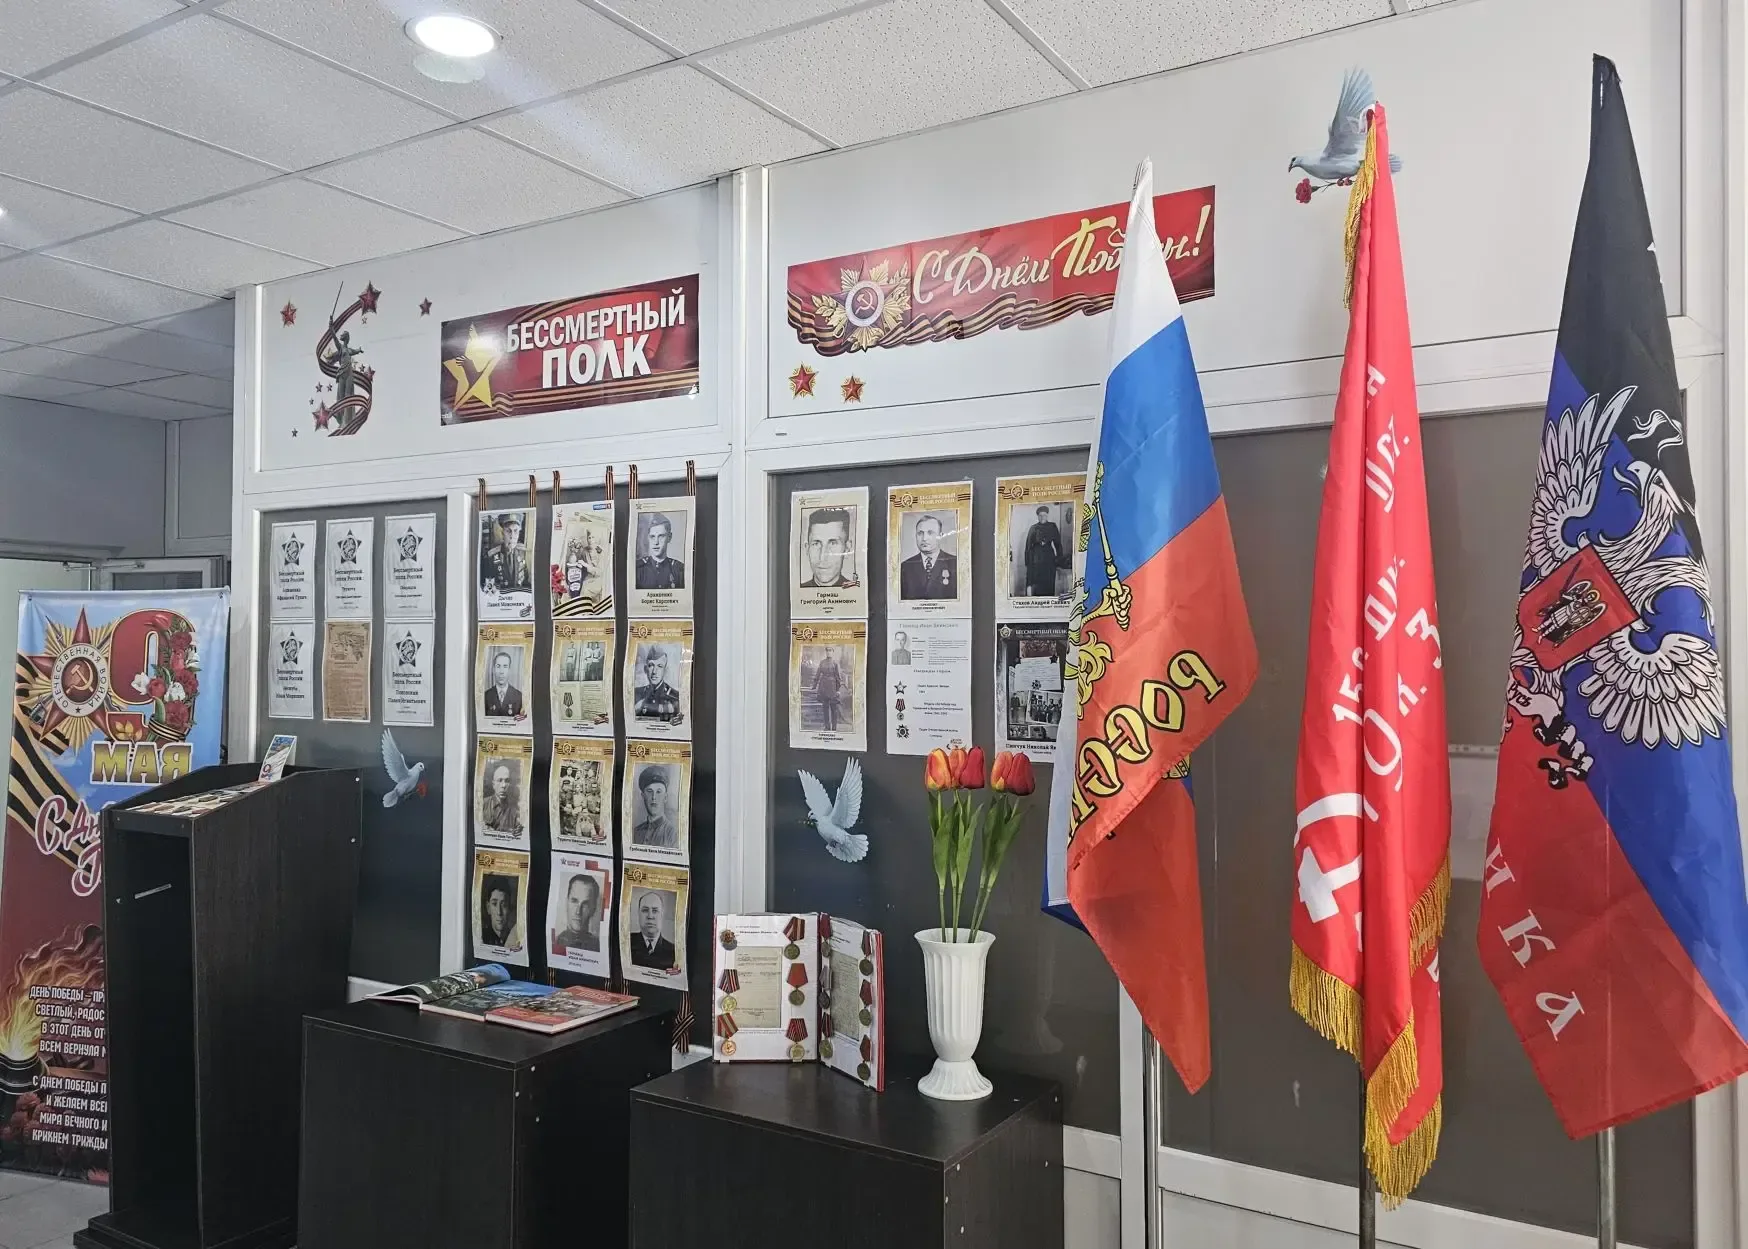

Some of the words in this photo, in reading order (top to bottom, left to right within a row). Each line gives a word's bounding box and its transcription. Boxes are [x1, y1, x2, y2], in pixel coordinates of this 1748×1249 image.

[913, 250, 943, 305] С
[944, 247, 1050, 298] Днём
[506, 286, 686, 353] БЕССМЕРТНЫЙ
[542, 334, 652, 389] ПОЛК
[53, 647, 102, 709] ОТЕЧЕСТВЕННАЯ
[88, 667, 107, 708] ВОЙНА
[90, 740, 194, 786] МАЯ
[35, 795, 67, 855] С
[29, 986, 50, 999] ДЕНЬ
[51, 987, 84, 1002] ПОБЕДЫ
[92, 990, 105, 1003] ПР
[35, 1004, 76, 1019] СВЕТЛЫЙ,
[41, 1023, 48, 1034] В
[49, 1023, 70, 1036] ЭТОТ
[70, 1025, 92, 1039] ДЕНЬ
[39, 1040, 62, 1053] ВСЕМ
[63, 1042, 100, 1057] ВЕРНУЛА
[32, 1075, 39, 1087] С
[39, 1077, 63, 1090] ДНЕМ
[64, 1079, 99, 1094] ПОБЕДЫ
[53, 1096, 88, 1111] ЖЕЛАЕМ
[90, 1100, 108, 1113] ВСЕ
[39, 1112, 62, 1126] МИРА
[64, 1115, 101, 1131] ВЕЧНОГО
[32, 1129, 70, 1145] КРИКНЕМ
[71, 1133, 109, 1150] ТРИЖДЫ
